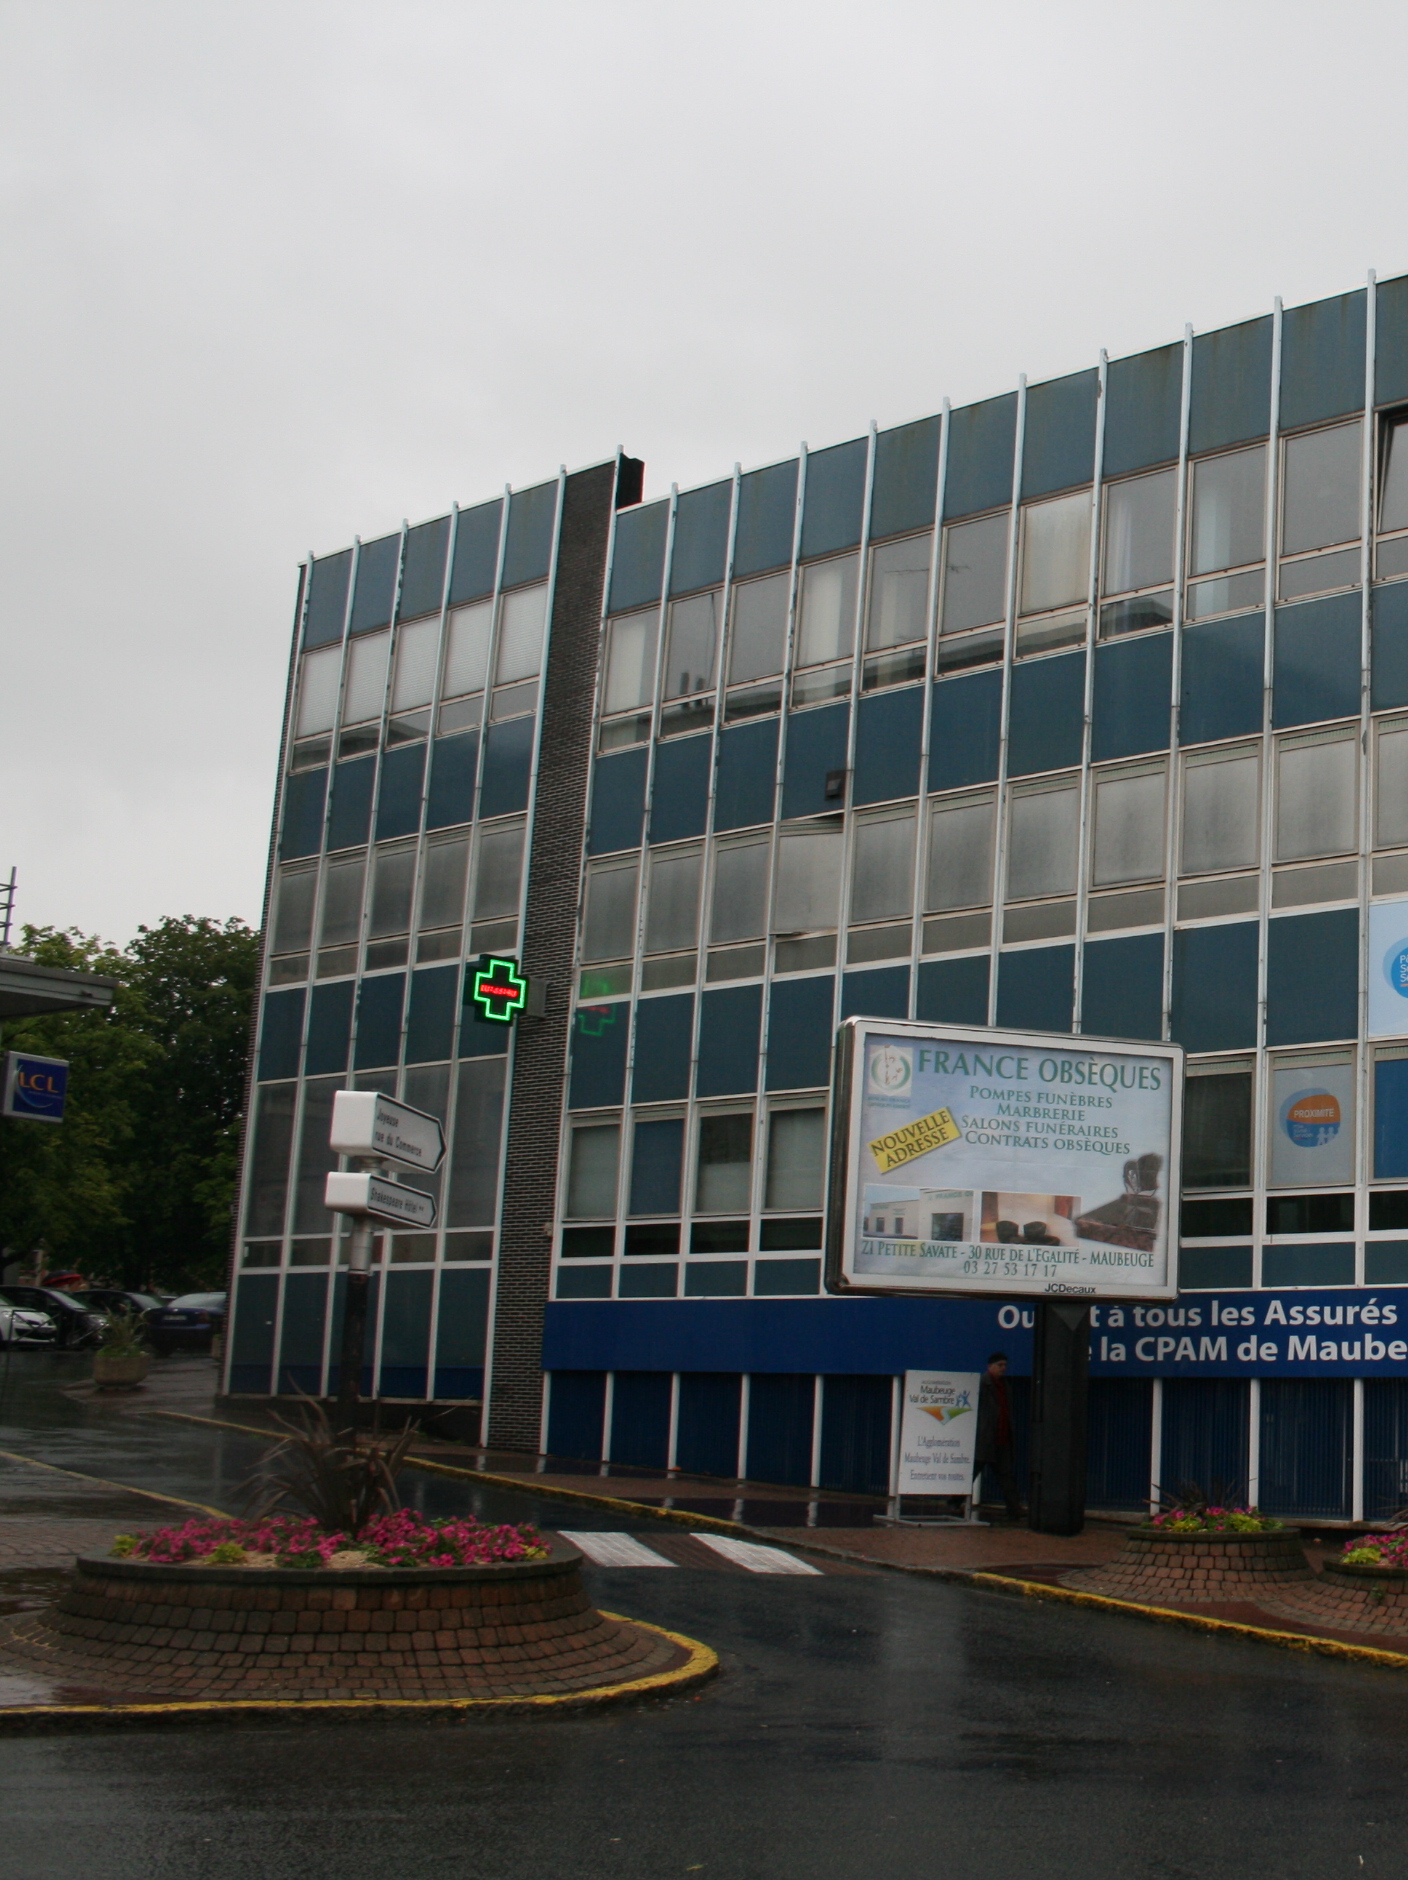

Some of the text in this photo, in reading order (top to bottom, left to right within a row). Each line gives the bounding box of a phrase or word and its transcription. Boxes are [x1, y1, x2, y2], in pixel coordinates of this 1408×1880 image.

[18, 1072, 59, 1093] LCL
[918, 1049, 1161, 1093] FRANCE OBSÈQUES
[970, 1085, 1112, 1108] POMPES FUNÈBRES
[997, 1103, 1085, 1121] MARBRERIE
[871, 1110, 949, 1156] NOUVELLE
[961, 1115, 1118, 1138] SALONS FUNÉRAIRES
[887, 1127, 949, 1167] ADRESSE
[965, 1131, 1130, 1155] CONTRATS OBSÈQUES
[878, 1242, 916, 1257] PETITE
[920, 1242, 957, 1259] SAVATE
[968, 1245, 982, 1260] 30
[985, 1248, 1005, 1261] RUE
[1009, 1250, 1023, 1262] DE
[1090, 1253, 1154, 1268] MAUBEUGE
[964, 1261, 1057, 1277] 03 27 53 17 17
[1044, 1283, 1096, 1294] JCDecaux
[998, 1305, 1100, 1328] Out
[1107, 1305, 1125, 1327] à
[1132, 1306, 1202, 1327] tous
[1211, 1300, 1255, 1326] les
[1263, 1298, 1398, 1325] Assurés
[1100, 1336, 1126, 1361] la
[1135, 1336, 1228, 1361] CPAM
[1236, 1335, 1279, 1361] de
[920, 1385, 956, 1396] Maubeuge
